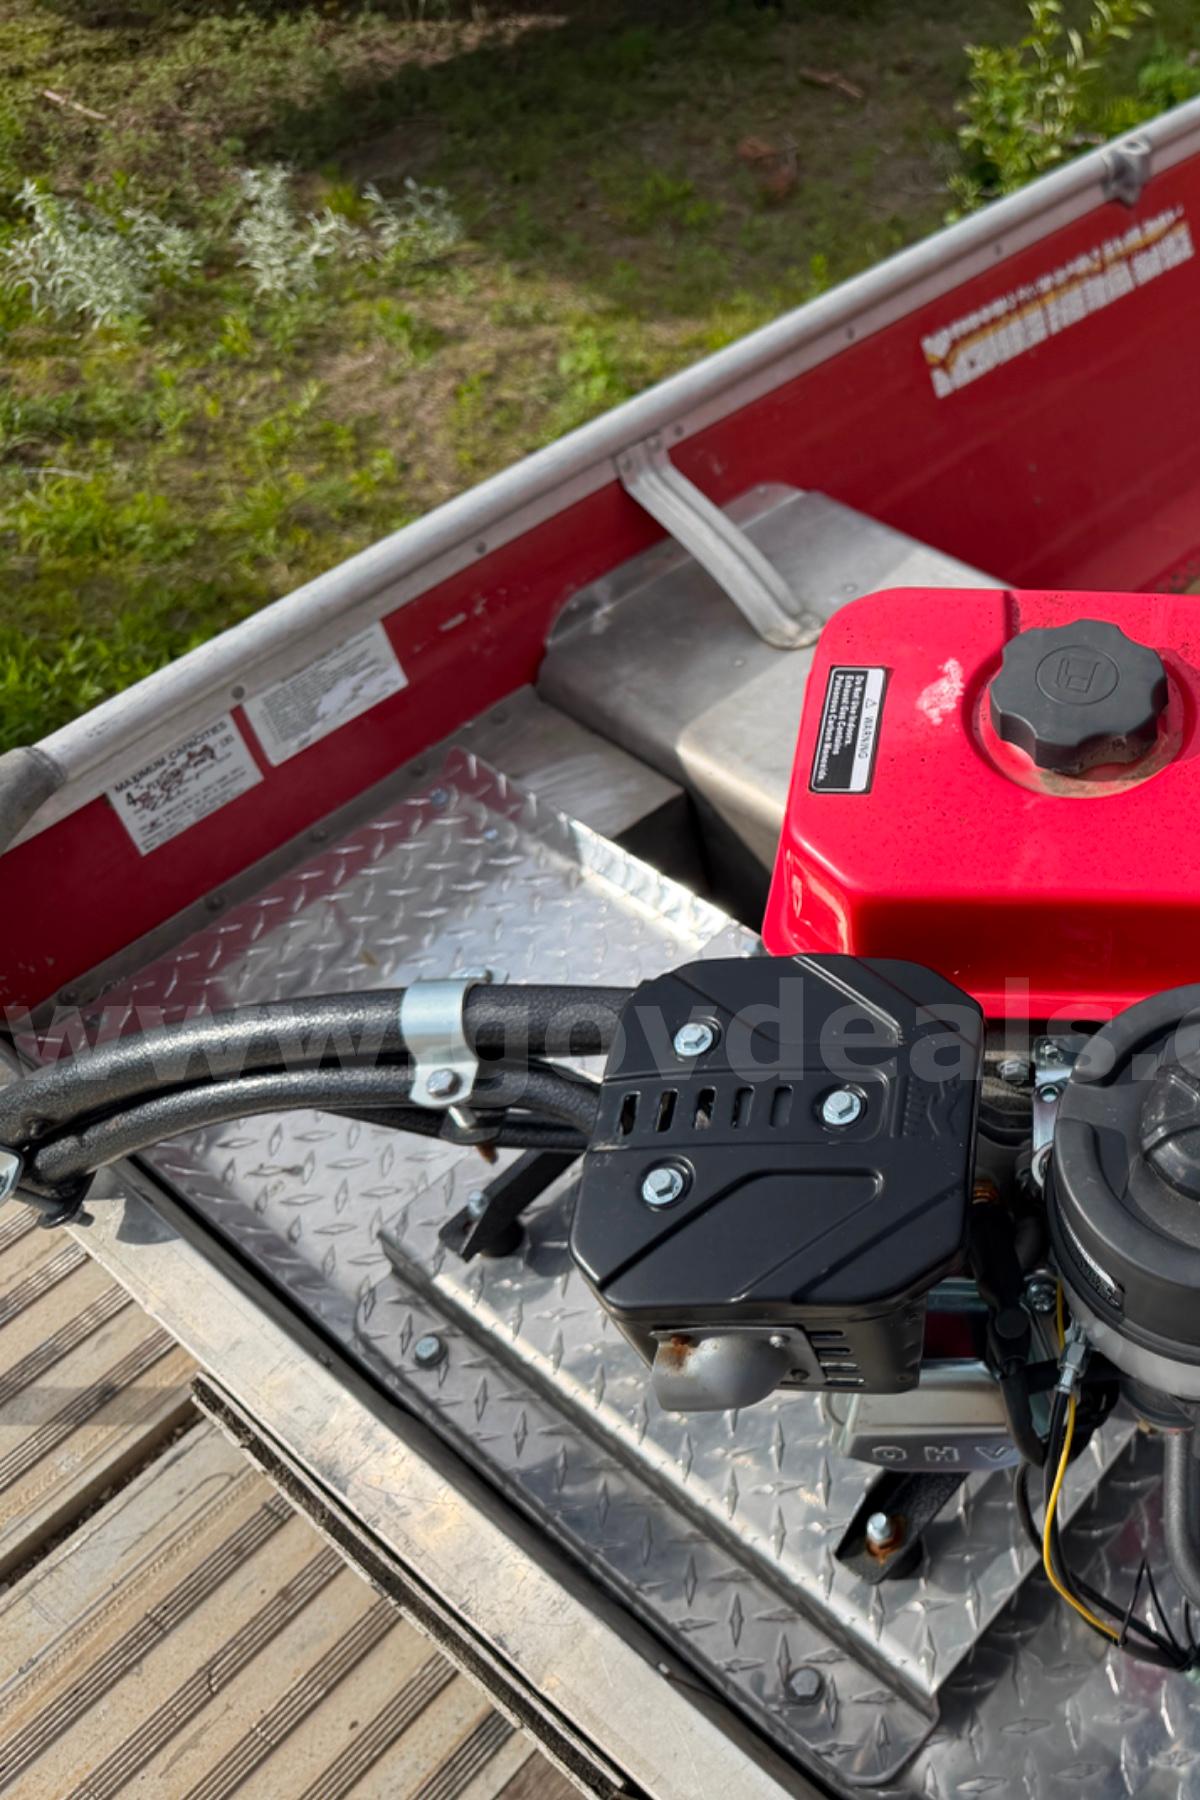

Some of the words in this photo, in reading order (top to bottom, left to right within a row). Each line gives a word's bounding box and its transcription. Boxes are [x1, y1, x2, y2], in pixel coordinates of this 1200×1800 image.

[859, 717, 873, 758] WARNING
[114, 757, 168, 793] MAXIMUM
[871, 1445, 1010, 1463] OHV
